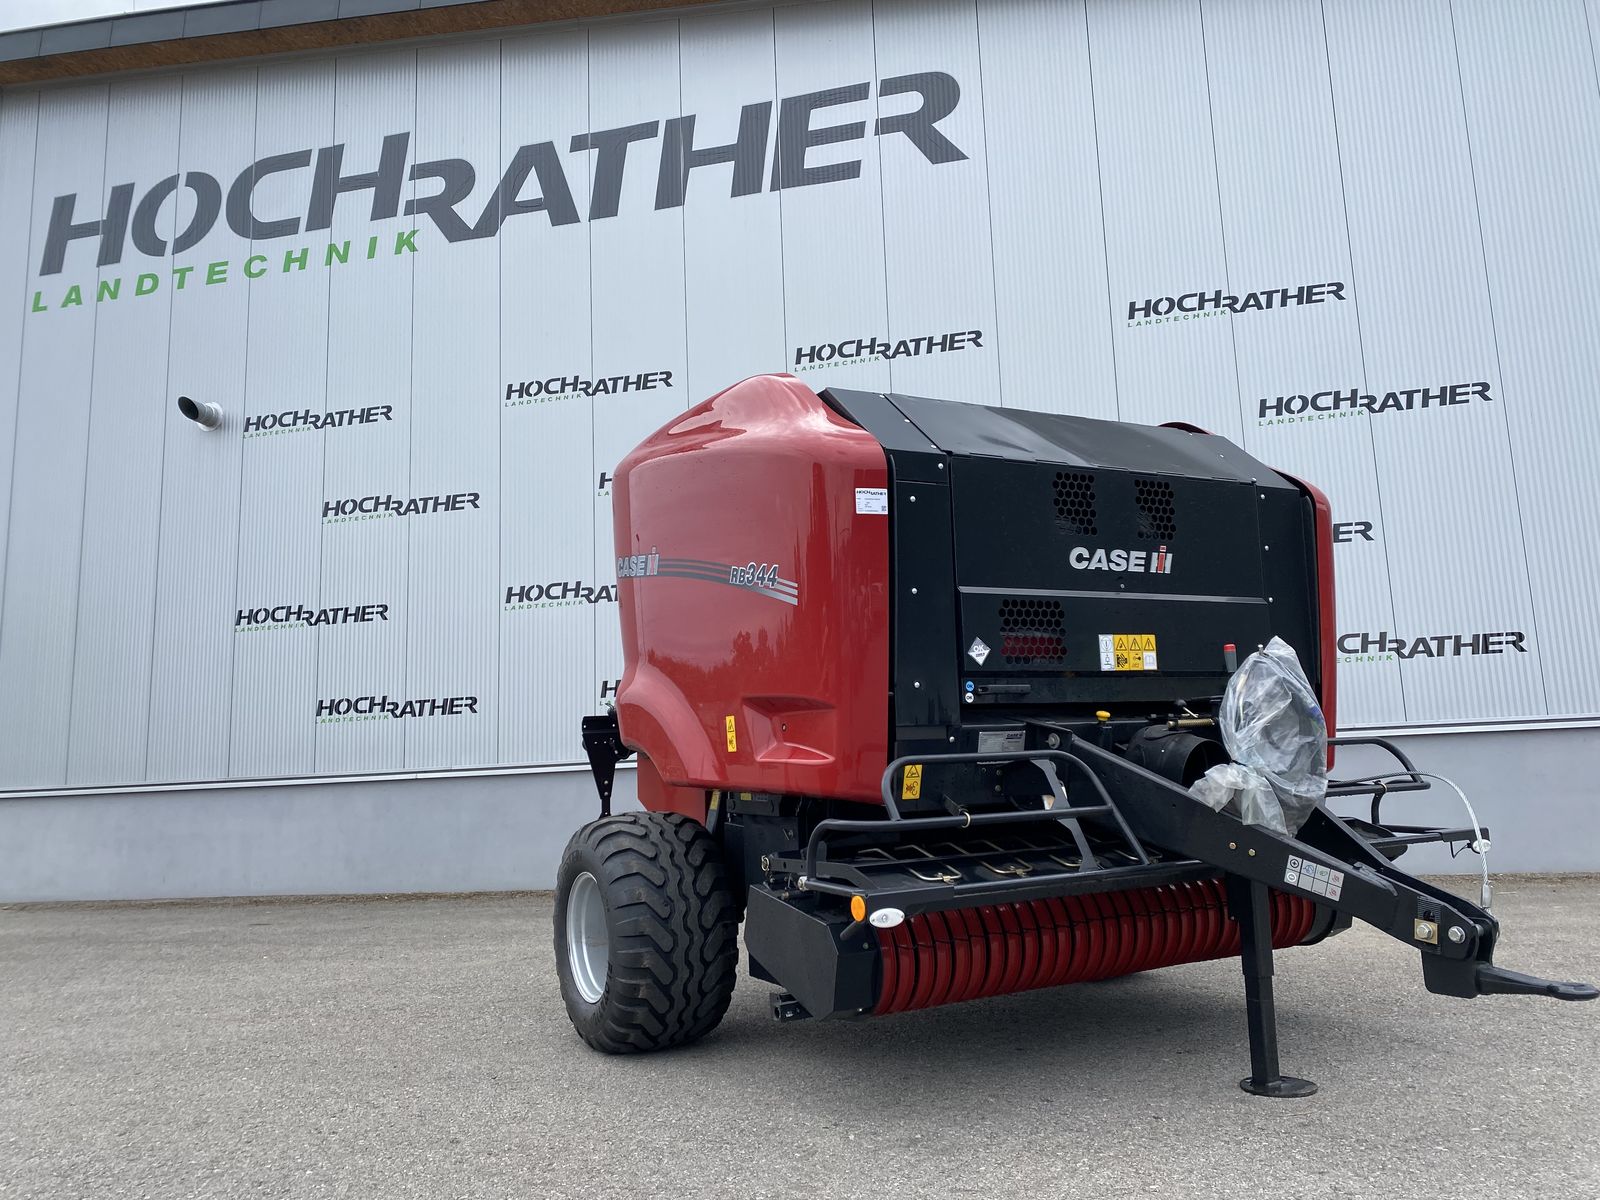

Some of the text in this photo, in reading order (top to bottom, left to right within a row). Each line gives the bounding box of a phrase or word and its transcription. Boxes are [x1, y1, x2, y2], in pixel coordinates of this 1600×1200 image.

[39, 71, 969, 277] HOCHRATHER
[31, 229, 420, 313] LANDTECHNIK
[1128, 282, 1346, 321] HOCHRATHER
[1127, 309, 1227, 328] LANDTECHNIK
[795, 330, 983, 365] HOCHRATHER
[794, 356, 880, 373] LANDTECHNIK
[505, 370, 673, 401] HOCHRATHER
[504, 393, 582, 408] LANDTECHNIK
[1258, 382, 1493, 418] HOCHRATHER
[243, 405, 393, 433] HOCHRATHER
[1258, 410, 1365, 427] LANDTECHNIK
[322, 492, 480, 518] HOCHRATHER
[617, 556, 646, 578] CASE
[1069, 546, 1147, 573] CASE
[729, 561, 779, 588] RB344
[505, 580, 619, 604] HOCHRAT
[235, 604, 389, 627] HOCHRATHER
[504, 600, 584, 611] LANDTECHNIK
[973, 645, 985, 653] OK
[1337, 631, 1528, 659] CHRATHER
[1336, 655, 1393, 664] ECHNIK
[315, 695, 478, 719] HOCHRATHER
